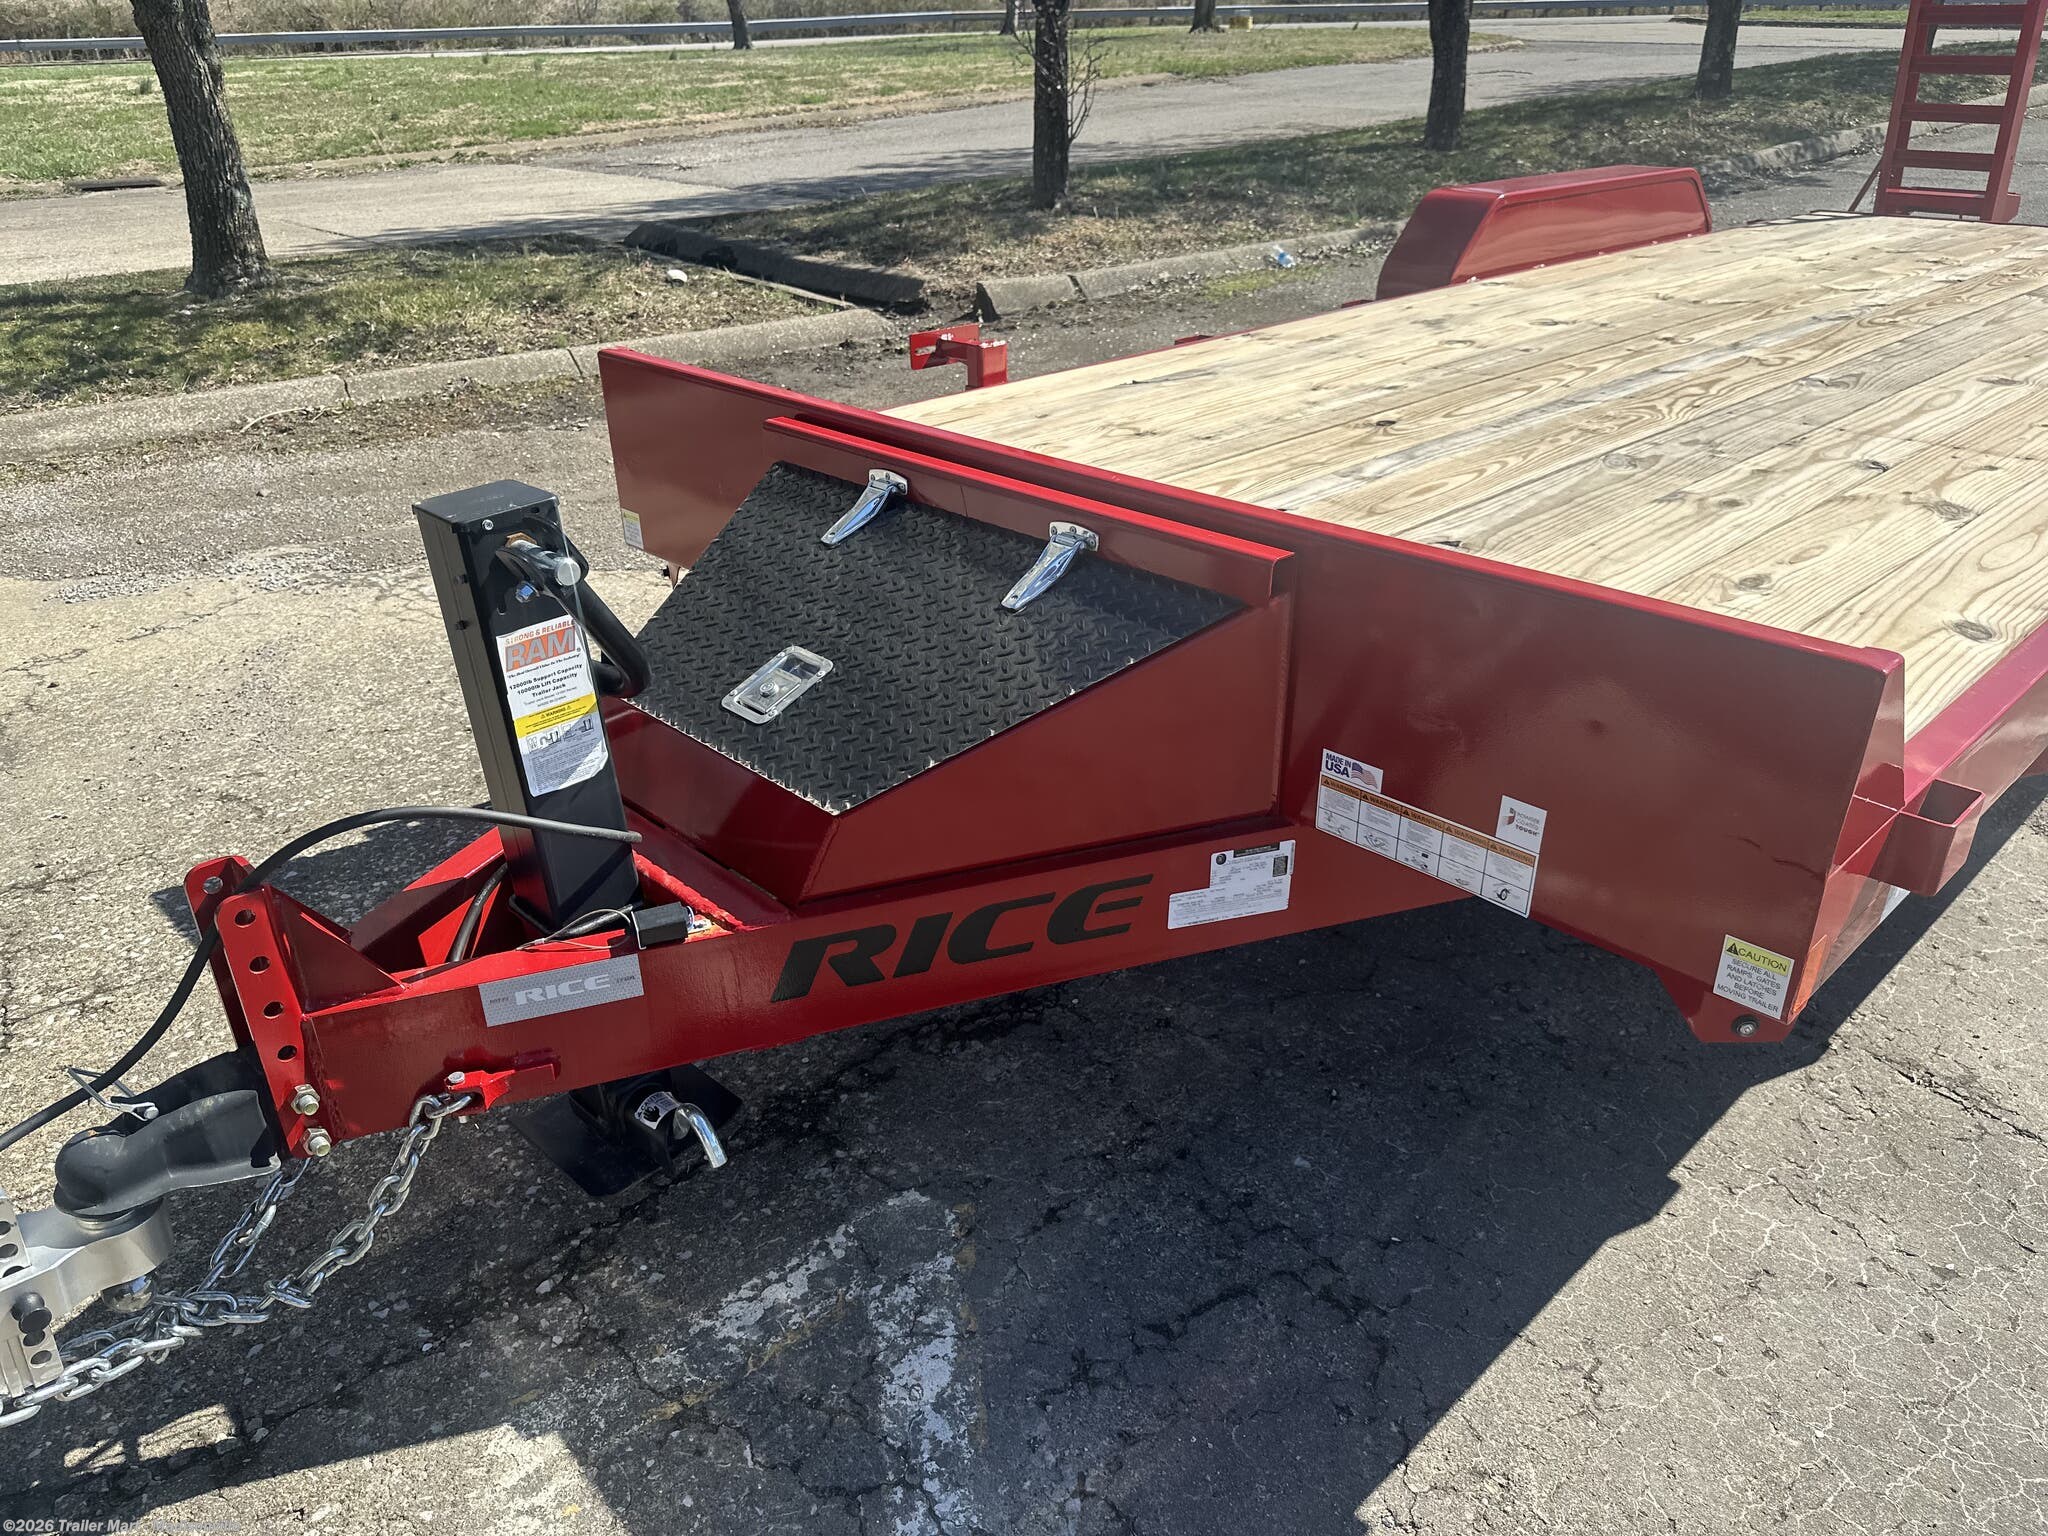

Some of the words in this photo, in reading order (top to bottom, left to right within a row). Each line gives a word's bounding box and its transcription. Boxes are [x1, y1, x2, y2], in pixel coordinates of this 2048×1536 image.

[505, 630, 535, 645] STRONG
[535, 628, 541, 636] &
[541, 619, 576, 633] RELIABLE
[506, 627, 576, 672] RAM
[509, 679, 532, 690] 12000lb
[533, 671, 556, 683] Support
[556, 663, 582, 675] Capacity
[517, 684, 540, 695] 10000lb
[540, 679, 552, 688] Lift
[552, 672, 578, 684] Capacity
[532, 687, 551, 698] Trailer
[552, 683, 566, 691] Jack
[545, 707, 566, 717] WARNING
[1325, 752, 1344, 765] MADE
[1344, 759, 1352, 768] IN
[1325, 760, 1350, 778] USA
[1330, 780, 1360, 796] WARNING
[1369, 796, 1401, 812] WARNING
[1410, 812, 1443, 829] WARNING
[1454, 828, 1488, 846] WARNING
[1499, 846, 1534, 865] WARNING
[769, 873, 1154, 1003] RICE
[1738, 948, 1787, 971] CAUTION
[1731, 958, 1763, 974] SECURE
[1763, 969, 1777, 981] ALL
[514, 973, 610, 1006] RICE
[1726, 973, 1743, 982] AND
[1744, 979, 1777, 996] LATCHES
[1734, 982, 1765, 999] BEFORE
[1756, 976, 1781, 990] GATES
[1717, 983, 1746, 999] MOVING
[1748, 995, 1779, 1012] TRAILER
